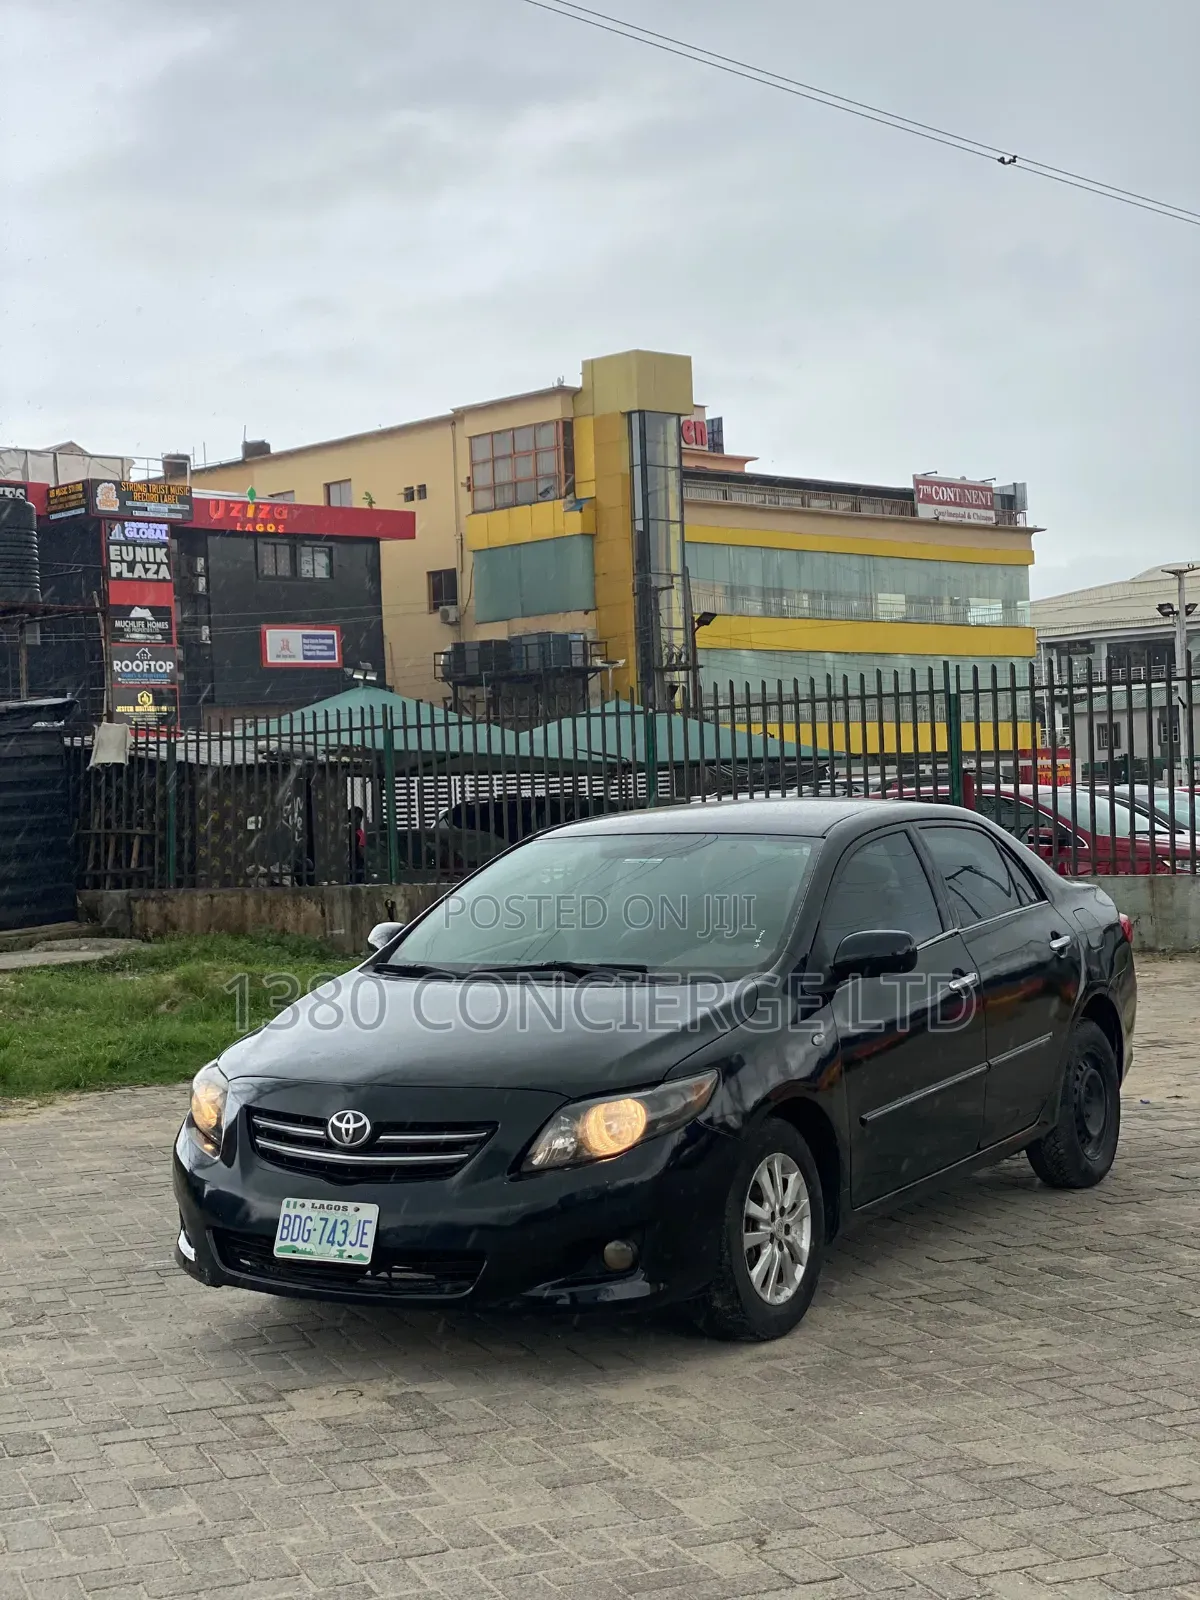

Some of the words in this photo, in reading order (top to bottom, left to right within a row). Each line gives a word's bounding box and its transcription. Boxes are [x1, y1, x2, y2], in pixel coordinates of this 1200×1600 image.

[121, 481, 147, 493] STRONG
[149, 483, 169, 494] TRUST
[170, 485, 190, 496] MUSIC
[133, 492, 159, 502] RECORD
[160, 494, 179, 504] LABEL
[932, 485, 992, 506] CONTNENT
[125, 527, 169, 540] GLOBAL
[236, 522, 285, 533] LAGOS
[109, 544, 169, 563] EUNIK
[110, 561, 171, 580] PLAZA
[114, 619, 145, 629] MUCHLIFE
[146, 621, 169, 629] HOMES
[113, 660, 174, 673] ROOFTOP
[311, 1202, 349, 1212] LAGOS
